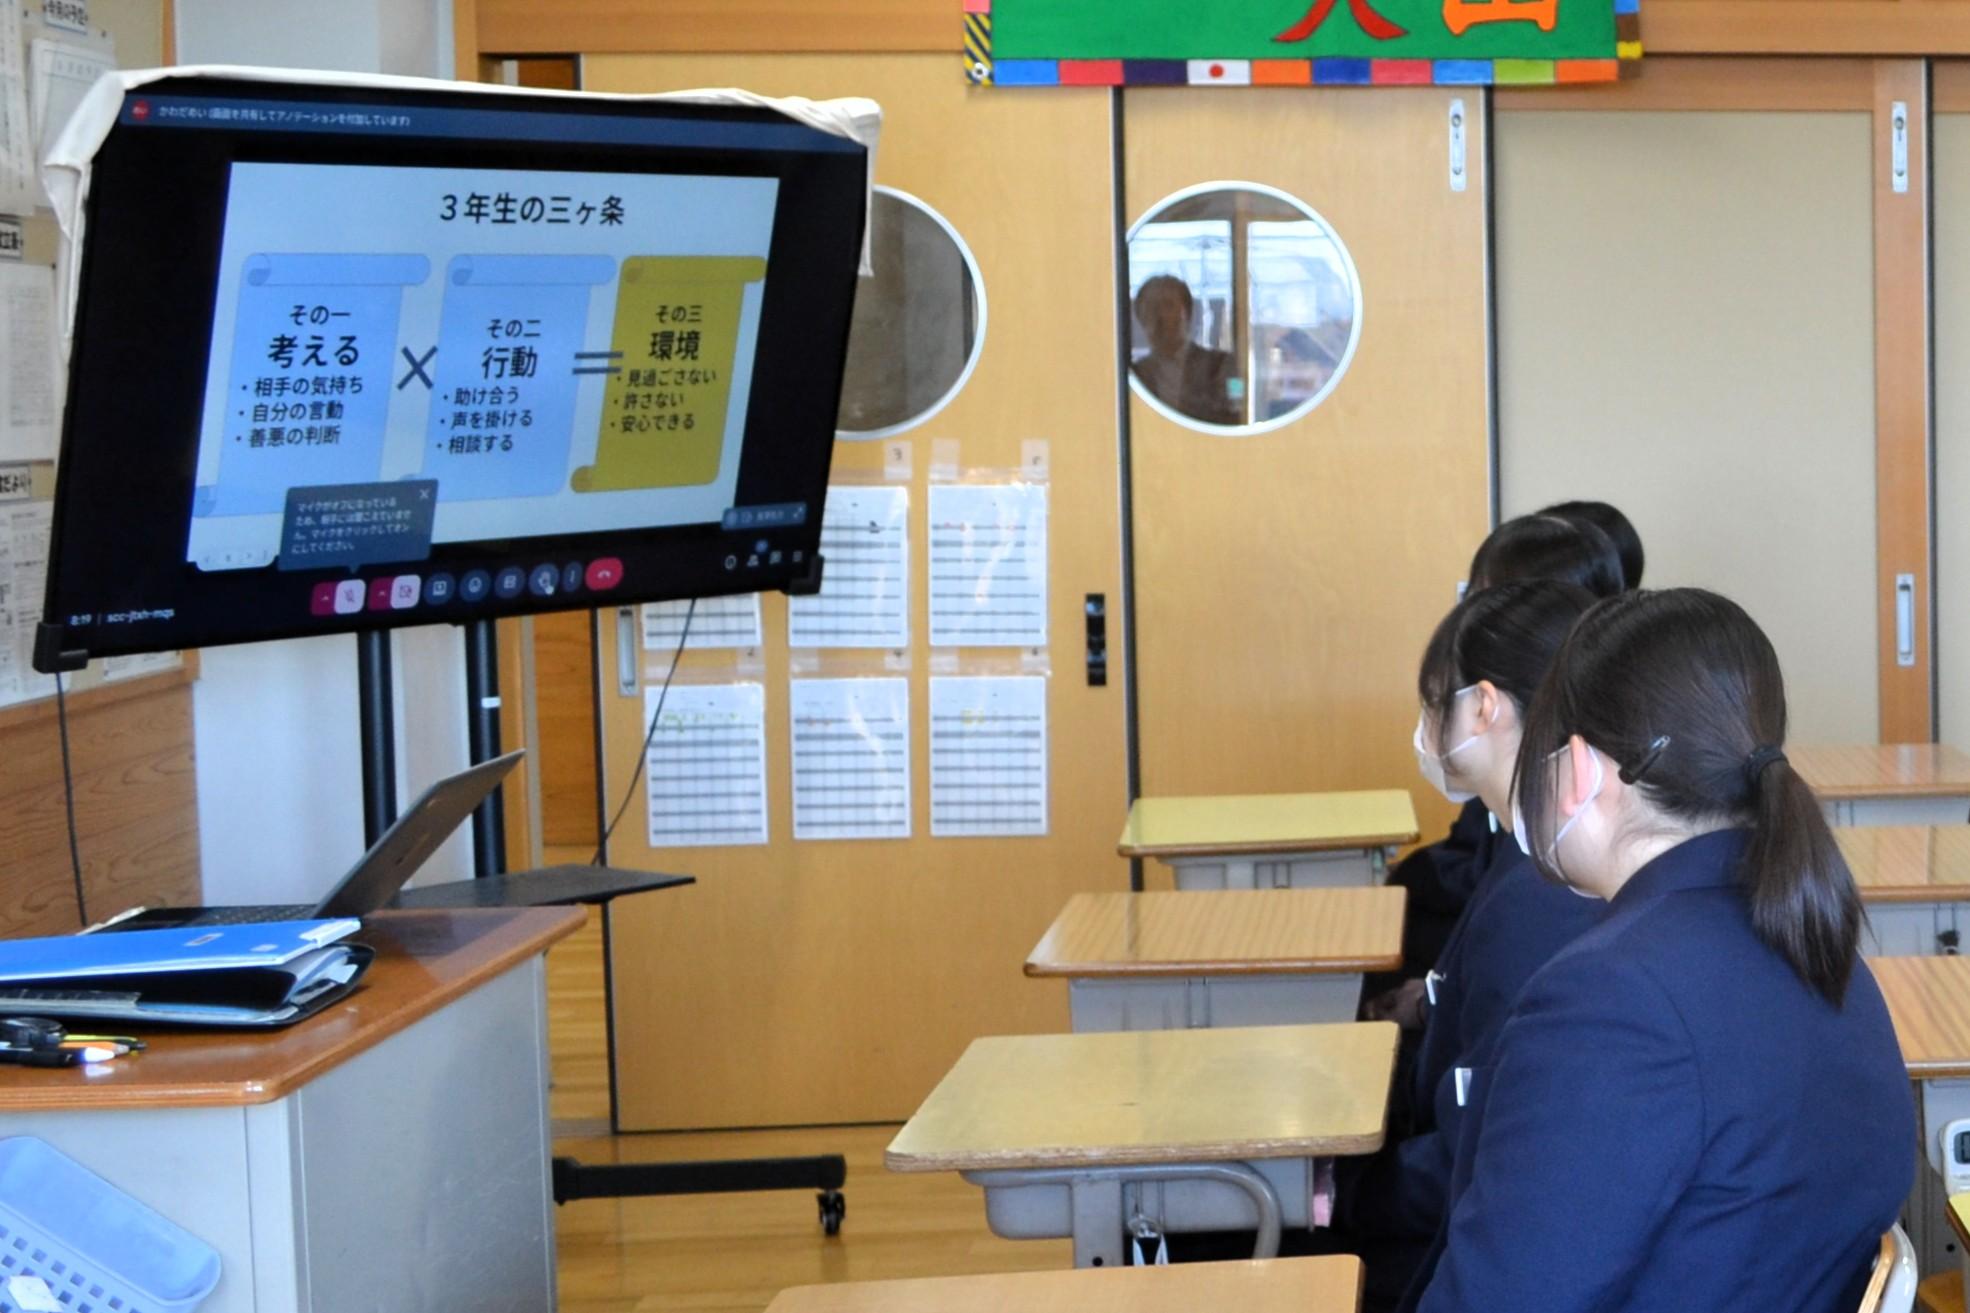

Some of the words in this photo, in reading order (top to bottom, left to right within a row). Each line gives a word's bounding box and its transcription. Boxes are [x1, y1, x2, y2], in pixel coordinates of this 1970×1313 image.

[290, 305, 351, 326] その一
[656, 305, 702, 323] その三
[487, 319, 541, 339] その二
[267, 334, 359, 369] 考える
[648, 330, 701, 361] 環境
[481, 345, 538, 379] 行動
[254, 376, 363, 397] 相手の気持ち
[627, 368, 717, 387] 見過ごさない
[454, 386, 519, 406] 助け合う
[624, 392, 684, 409] 許さない
[252, 400, 344, 423] 自分の言動
[451, 410, 532, 429] 声を掛ける
[622, 413, 695, 433] 安心できる
[248, 424, 341, 448] 善悪の判断
[448, 434, 513, 455] 相談する
